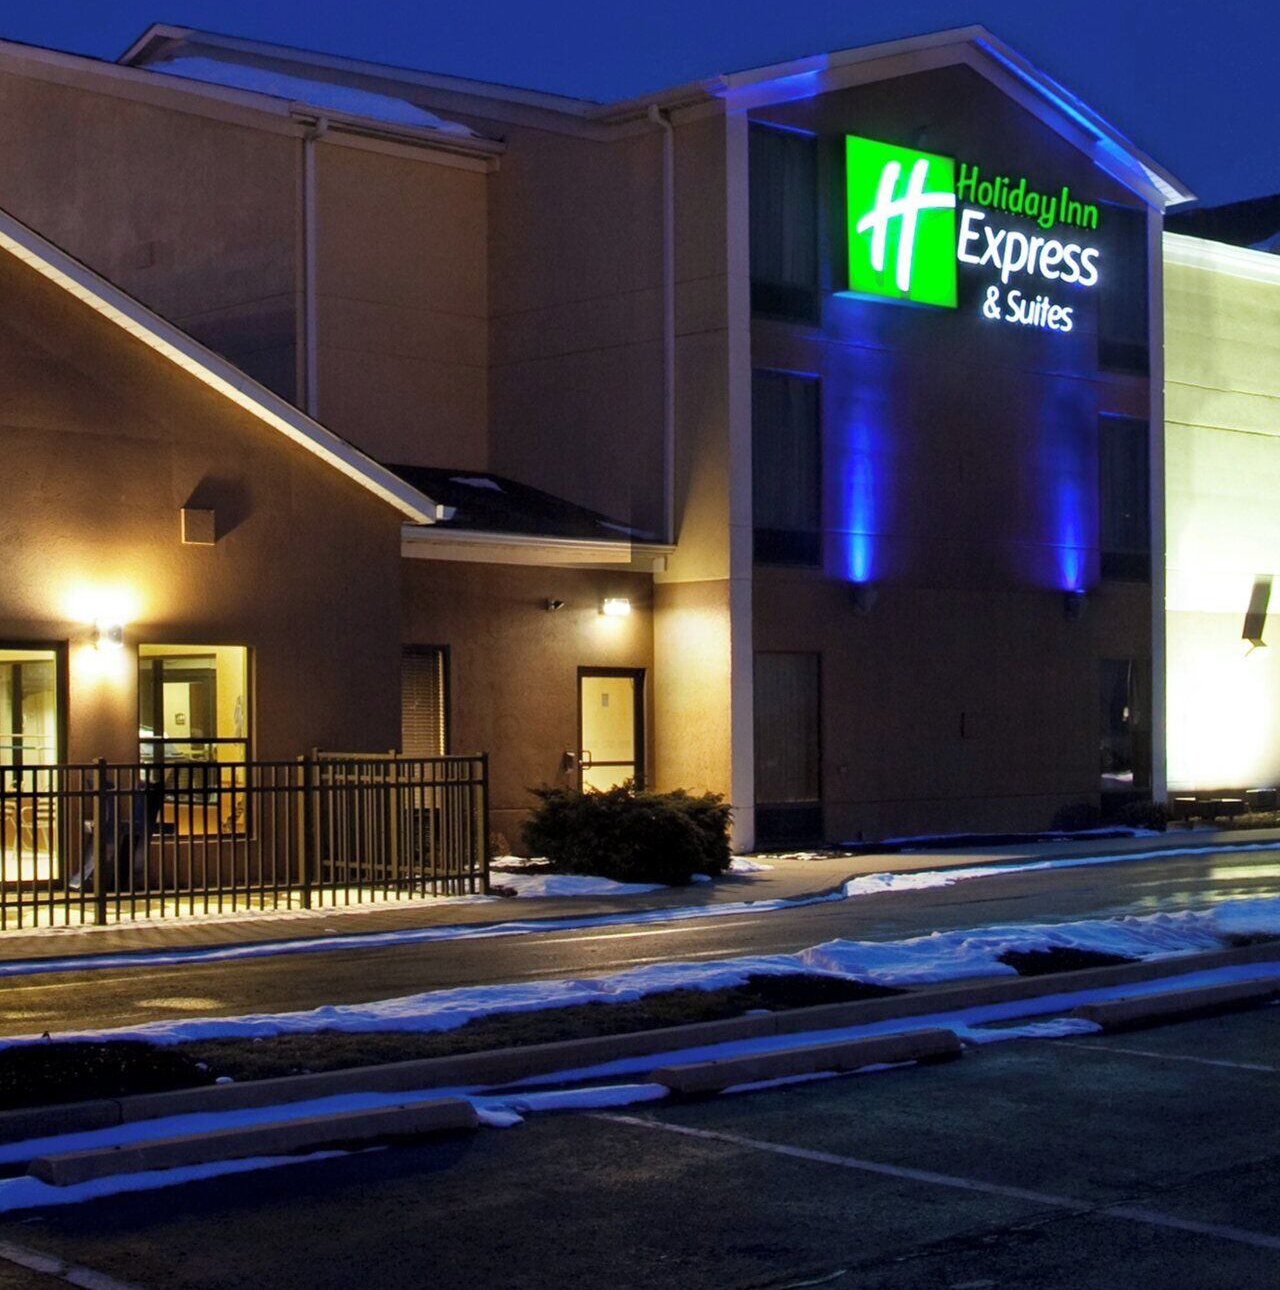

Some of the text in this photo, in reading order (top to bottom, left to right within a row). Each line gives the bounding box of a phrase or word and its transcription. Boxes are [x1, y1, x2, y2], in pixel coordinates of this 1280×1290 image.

[957, 163, 1099, 230] Holiday Inn
[957, 208, 1100, 287] Express
[982, 285, 1074, 333] & Suites
